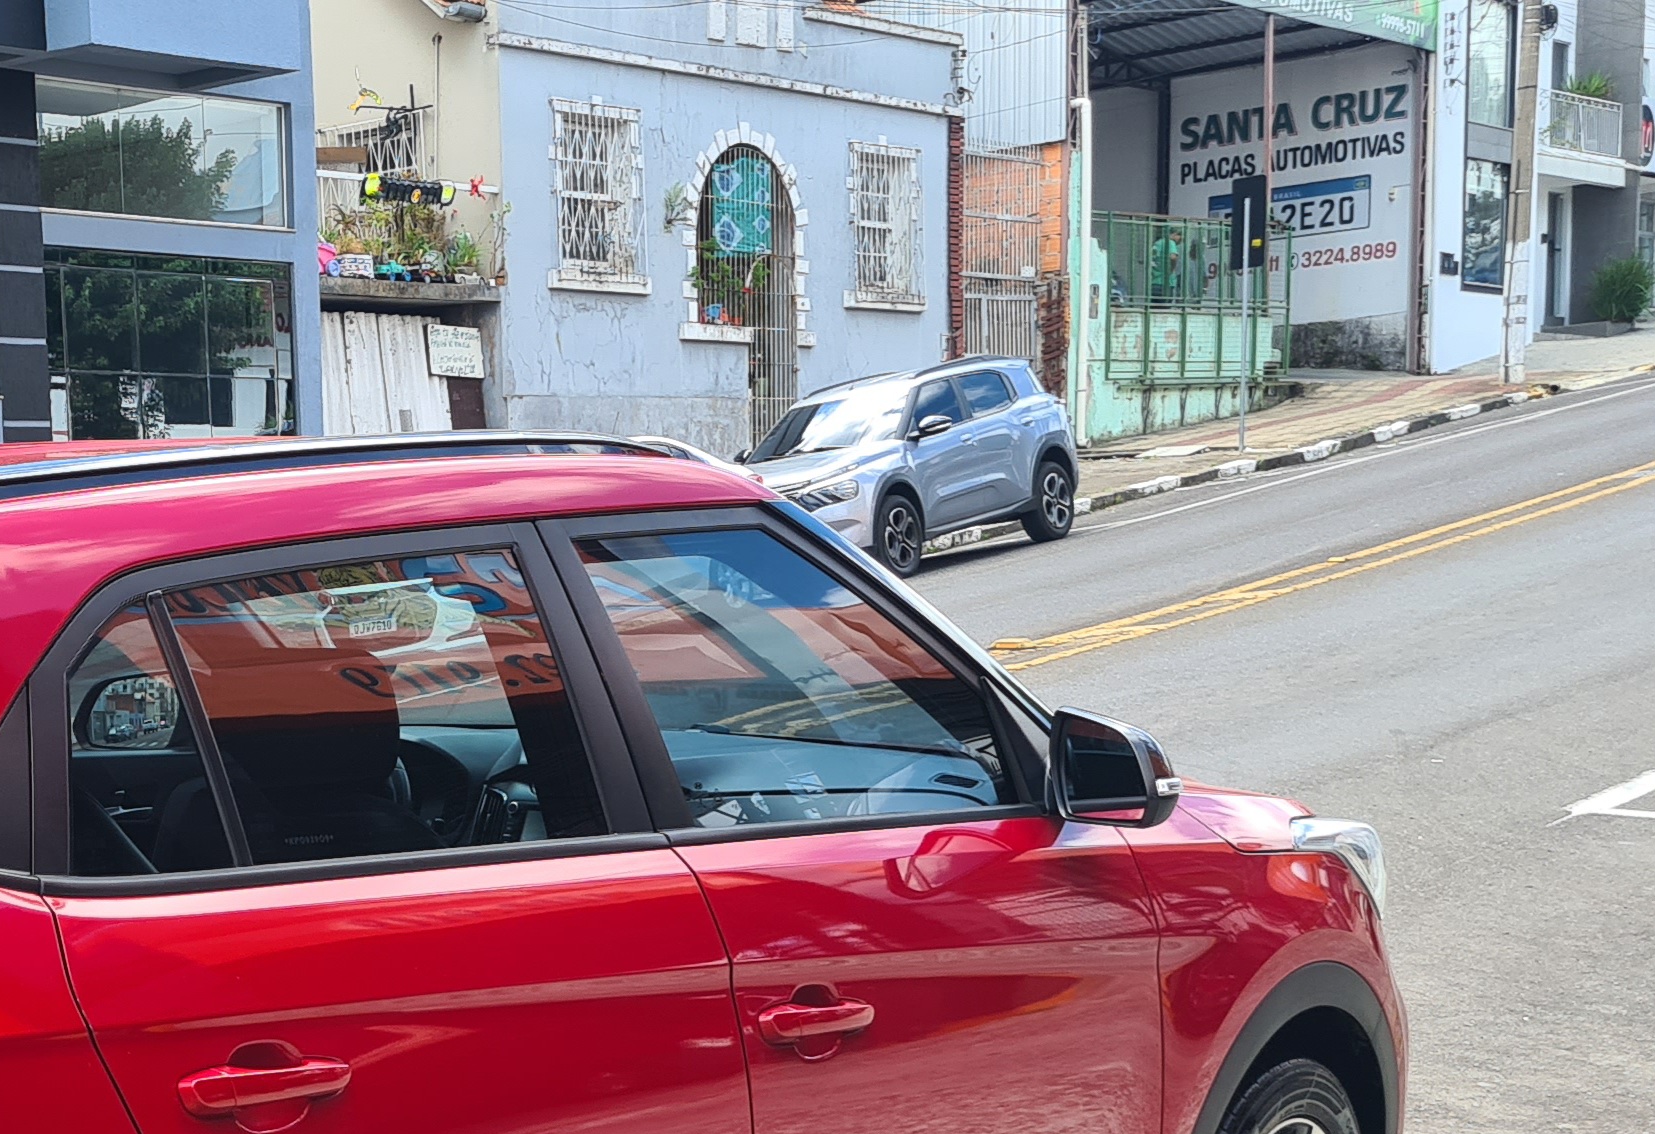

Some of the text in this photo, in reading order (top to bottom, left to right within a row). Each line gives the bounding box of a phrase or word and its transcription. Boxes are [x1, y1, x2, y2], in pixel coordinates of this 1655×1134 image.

[1180, 83, 1409, 152] SANTA CRUZ
[1181, 153, 1255, 185] PLACAS
[1301, 241, 1397, 269] 3224.8989
